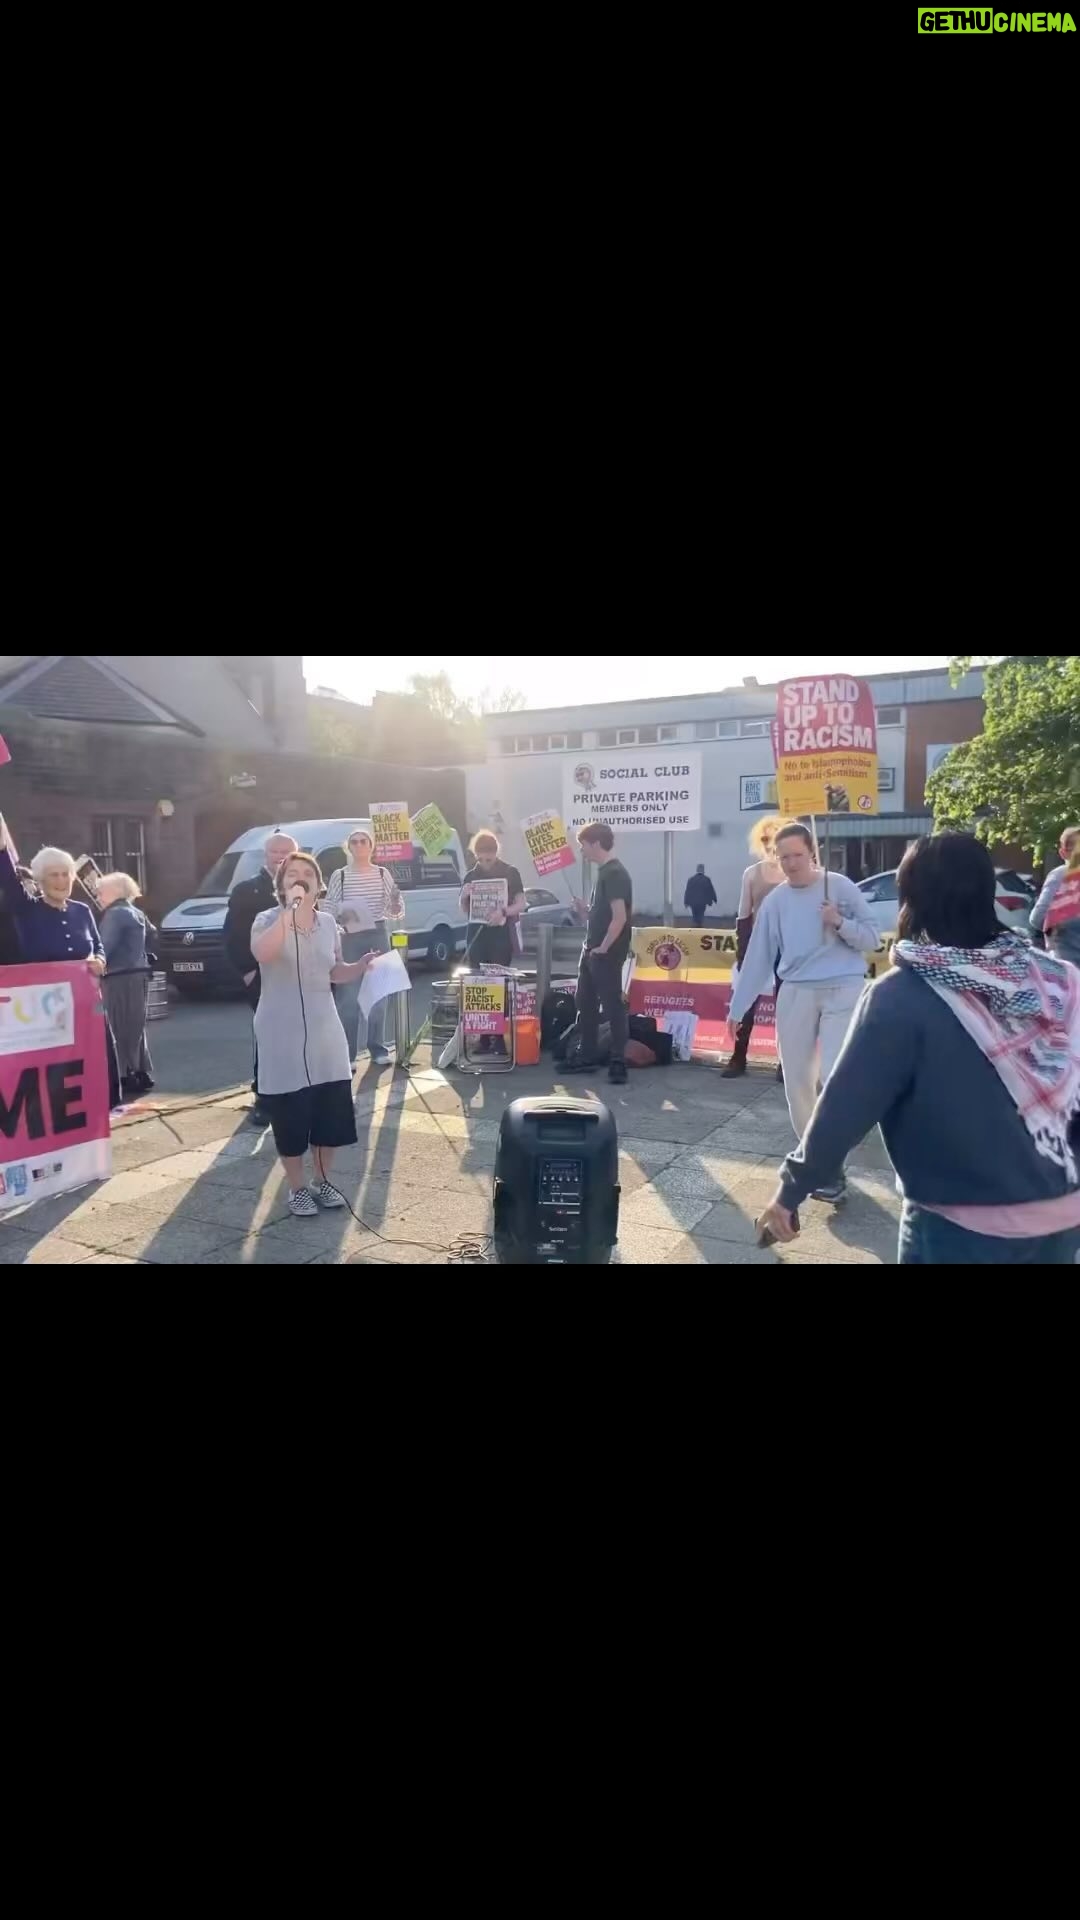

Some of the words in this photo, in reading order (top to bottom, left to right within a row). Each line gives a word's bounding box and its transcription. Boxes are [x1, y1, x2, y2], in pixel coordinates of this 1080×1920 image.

[783, 678, 860, 705] STAND
[784, 705, 817, 729] UP
[824, 702, 854, 725] TO
[783, 725, 873, 751] RACISM
[784, 761, 797, 770] No
[800, 761, 810, 769] to
[600, 768, 648, 779] SOCIAL
[654, 766, 690, 777] CLUB
[784, 772, 801, 781] and
[573, 793, 626, 803] PRIVATE
[629, 790, 689, 802] PARKING
[591, 804, 639, 813] MEMBERS
[641, 803, 669, 812] ONLY
[372, 813, 401, 823] BLACK
[572, 818, 585, 826] NO
[669, 815, 689, 824] USE
[373, 823, 398, 833] LIVES
[525, 820, 554, 839] BLACK
[374, 832, 409, 842] MATTER
[528, 831, 553, 848] LIVES
[531, 837, 567, 857] MATTER
[465, 986, 487, 994] STOP
[465, 995, 494, 1003] RACIST
[644, 995, 694, 1006] REFUGEES
[465, 1003, 501, 1011] ATTACKS
[759, 1003, 775, 1011] NO
[465, 1013, 489, 1021] UNITE
[472, 1022, 497, 1030] FIGHT
